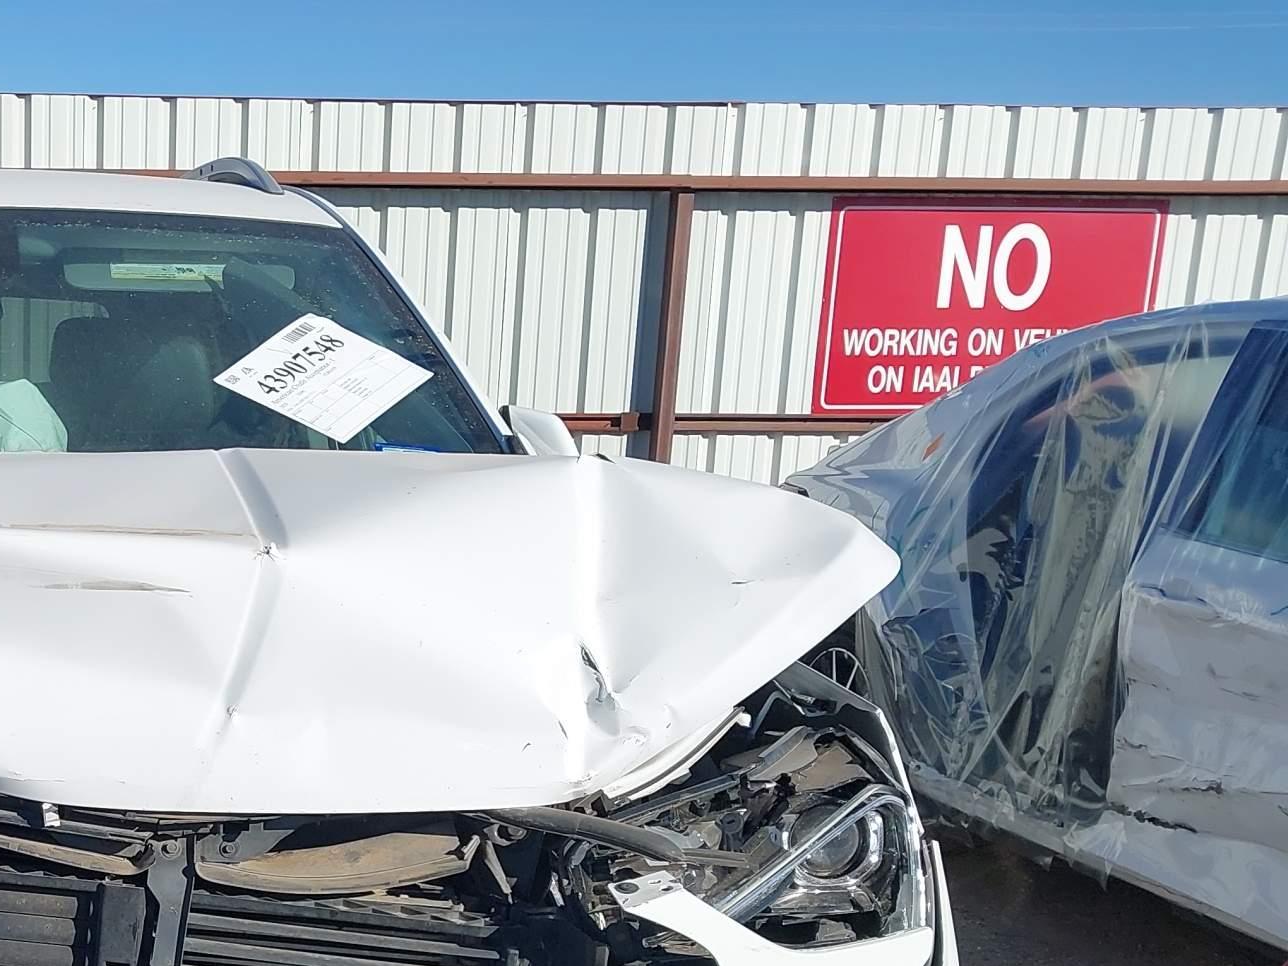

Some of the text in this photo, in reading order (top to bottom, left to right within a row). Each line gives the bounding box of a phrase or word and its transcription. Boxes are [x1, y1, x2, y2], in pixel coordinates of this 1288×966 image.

[936, 222, 1052, 311] NO
[256, 334, 345, 396] 43907548
[843, 327, 959, 357] WORKING
[967, 327, 1005, 357] ON
[867, 365, 904, 394] ON
